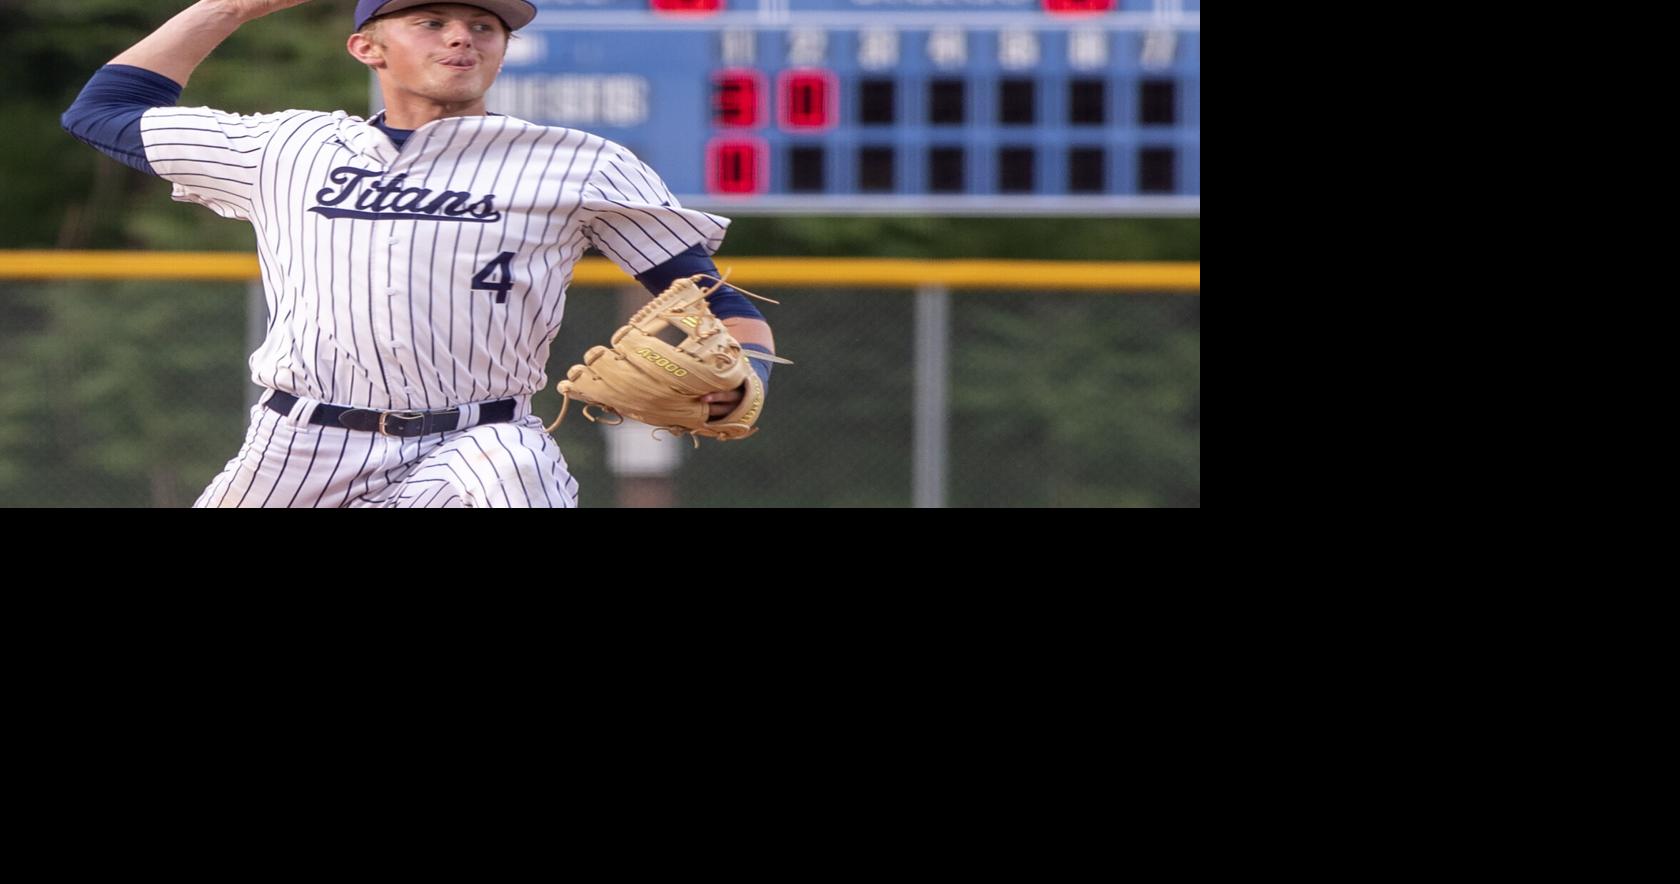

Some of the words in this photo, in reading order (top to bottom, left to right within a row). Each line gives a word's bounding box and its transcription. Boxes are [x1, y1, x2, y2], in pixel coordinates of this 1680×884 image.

[714, 71, 764, 131] 3
[780, 70, 838, 132] 0
[308, 166, 501, 223] Titans
[708, 137, 768, 196] 0
[471, 251, 516, 304] 4
[637, 348, 688, 377] A2000
